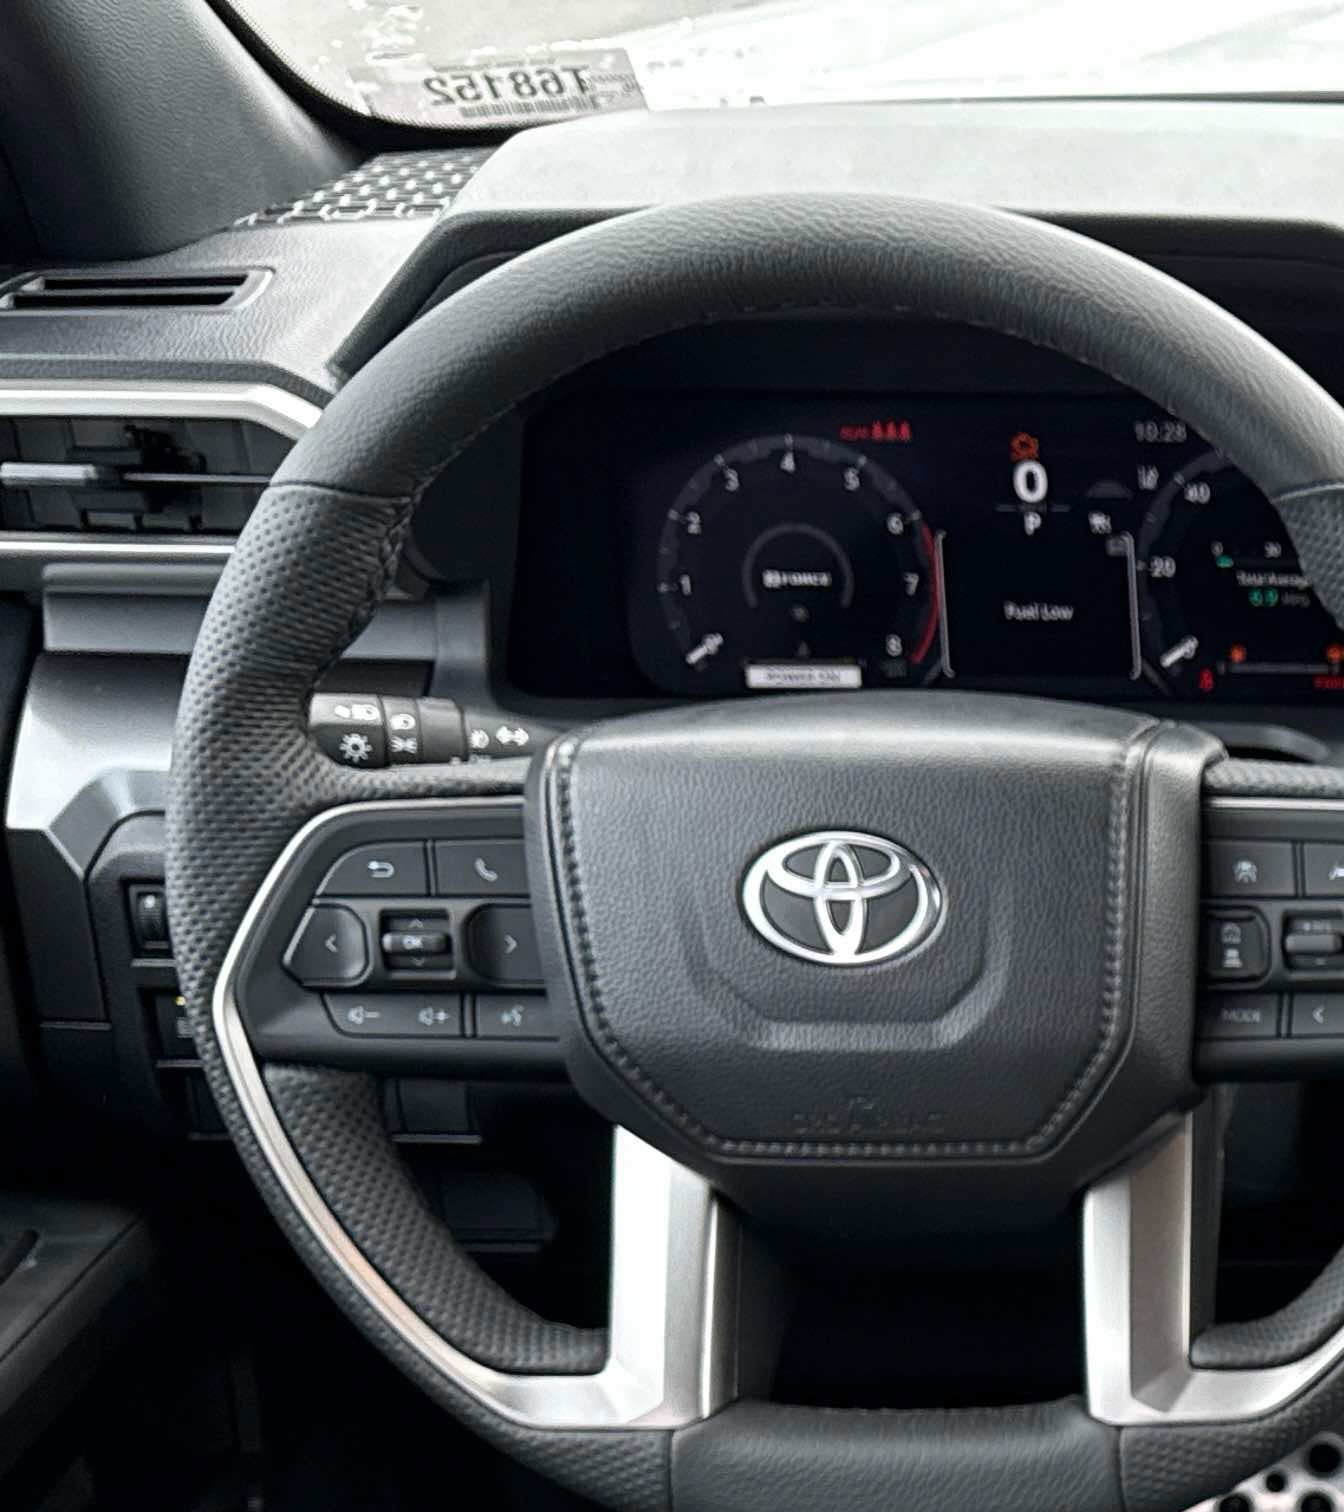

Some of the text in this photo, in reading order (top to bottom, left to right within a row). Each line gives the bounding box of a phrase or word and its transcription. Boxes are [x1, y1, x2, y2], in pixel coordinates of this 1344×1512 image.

[780, 453, 796, 473] 4
[724, 468, 740, 491] 3
[843, 467, 861, 491] 5
[1012, 460, 1049, 503] 0
[686, 511, 702, 535] 2
[886, 512, 904, 536] 6
[1024, 511, 1042, 536] P
[1151, 555, 1177, 578] 20
[679, 574, 692, 595] 1
[903, 572, 920, 596] 7
[885, 632, 903, 658] 8
